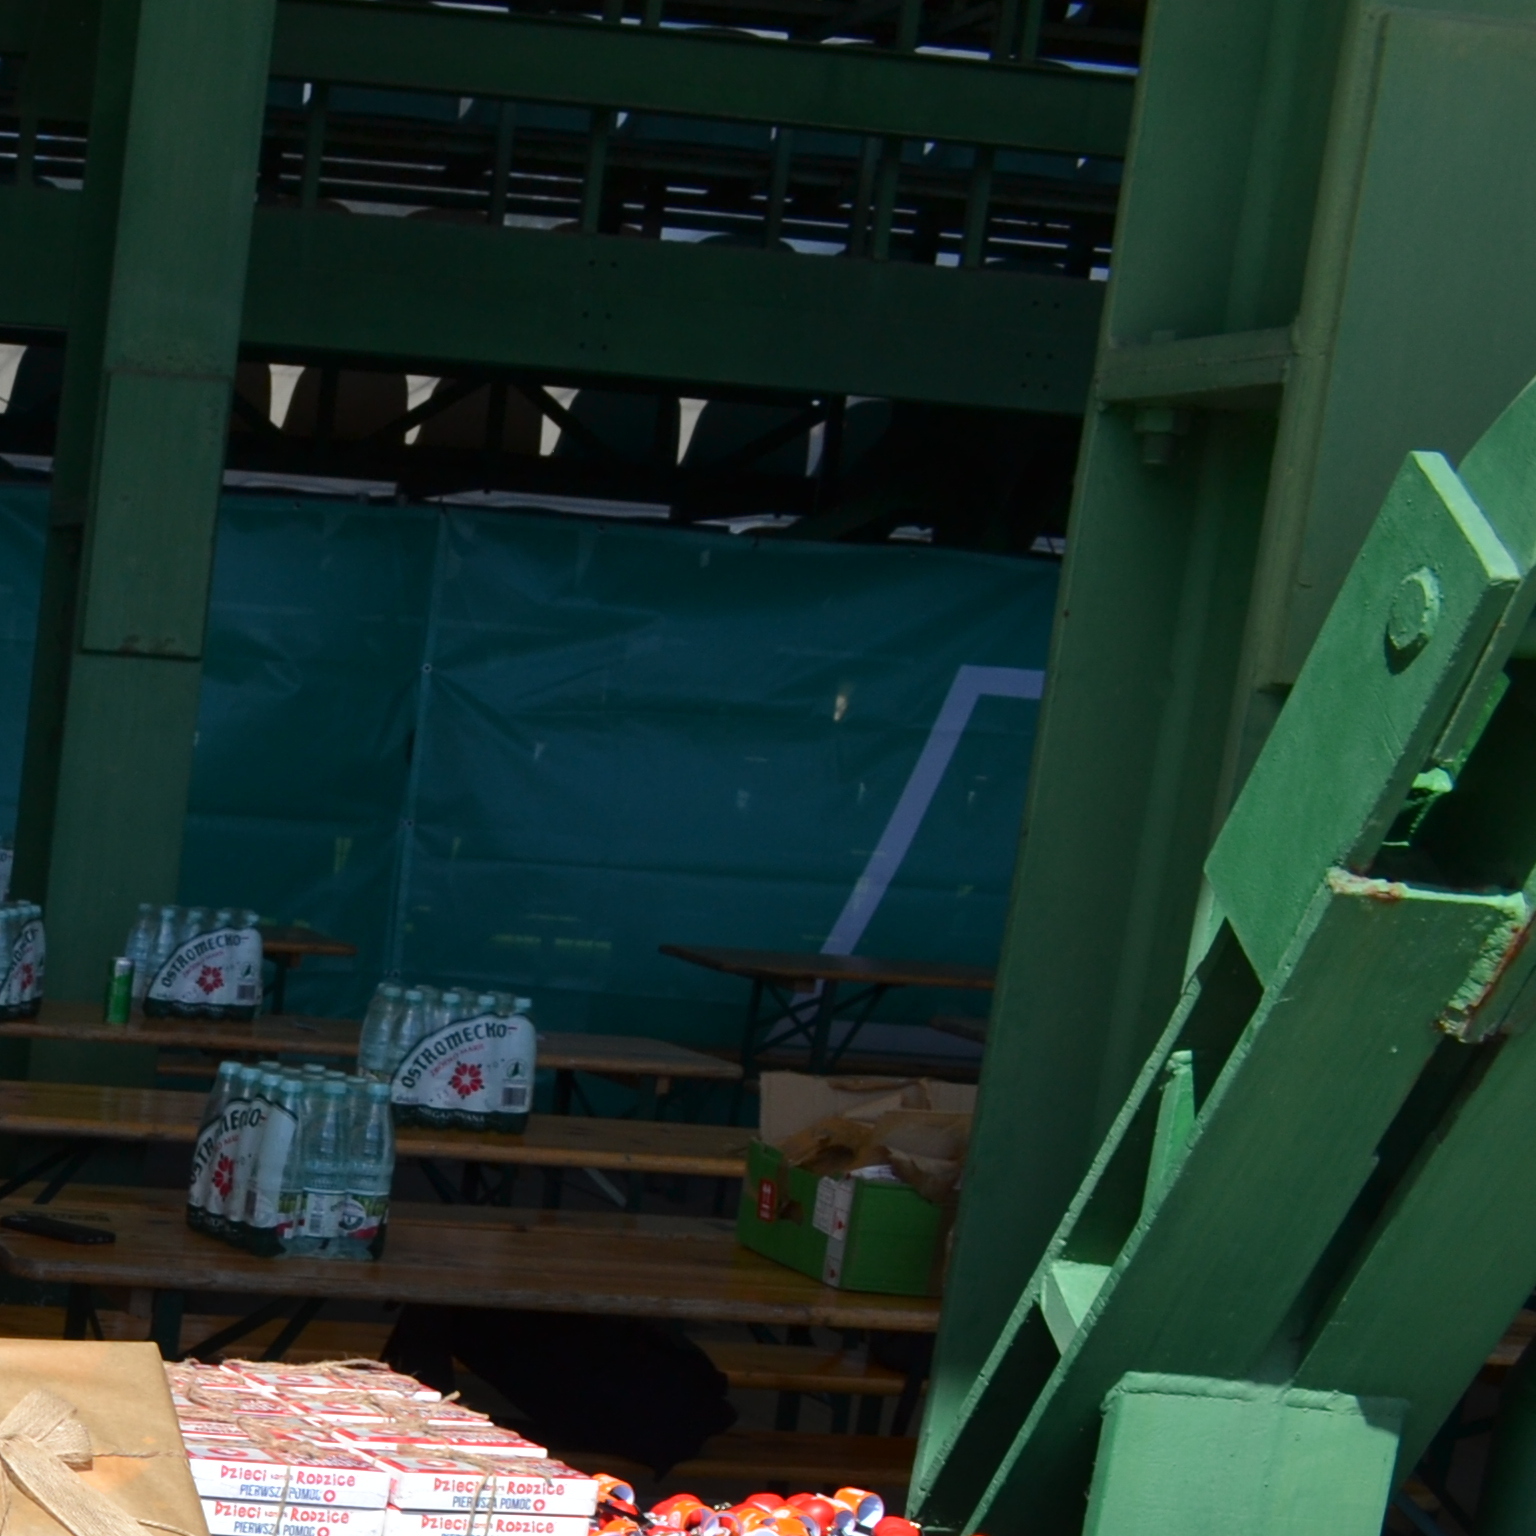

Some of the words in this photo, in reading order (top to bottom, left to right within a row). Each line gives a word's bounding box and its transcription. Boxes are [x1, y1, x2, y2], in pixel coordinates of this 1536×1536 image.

[240, 1484, 283, 1498] PIERWSZ
[288, 1487, 322, 1500] POMOC
[500, 1497, 532, 1511] POMOC
